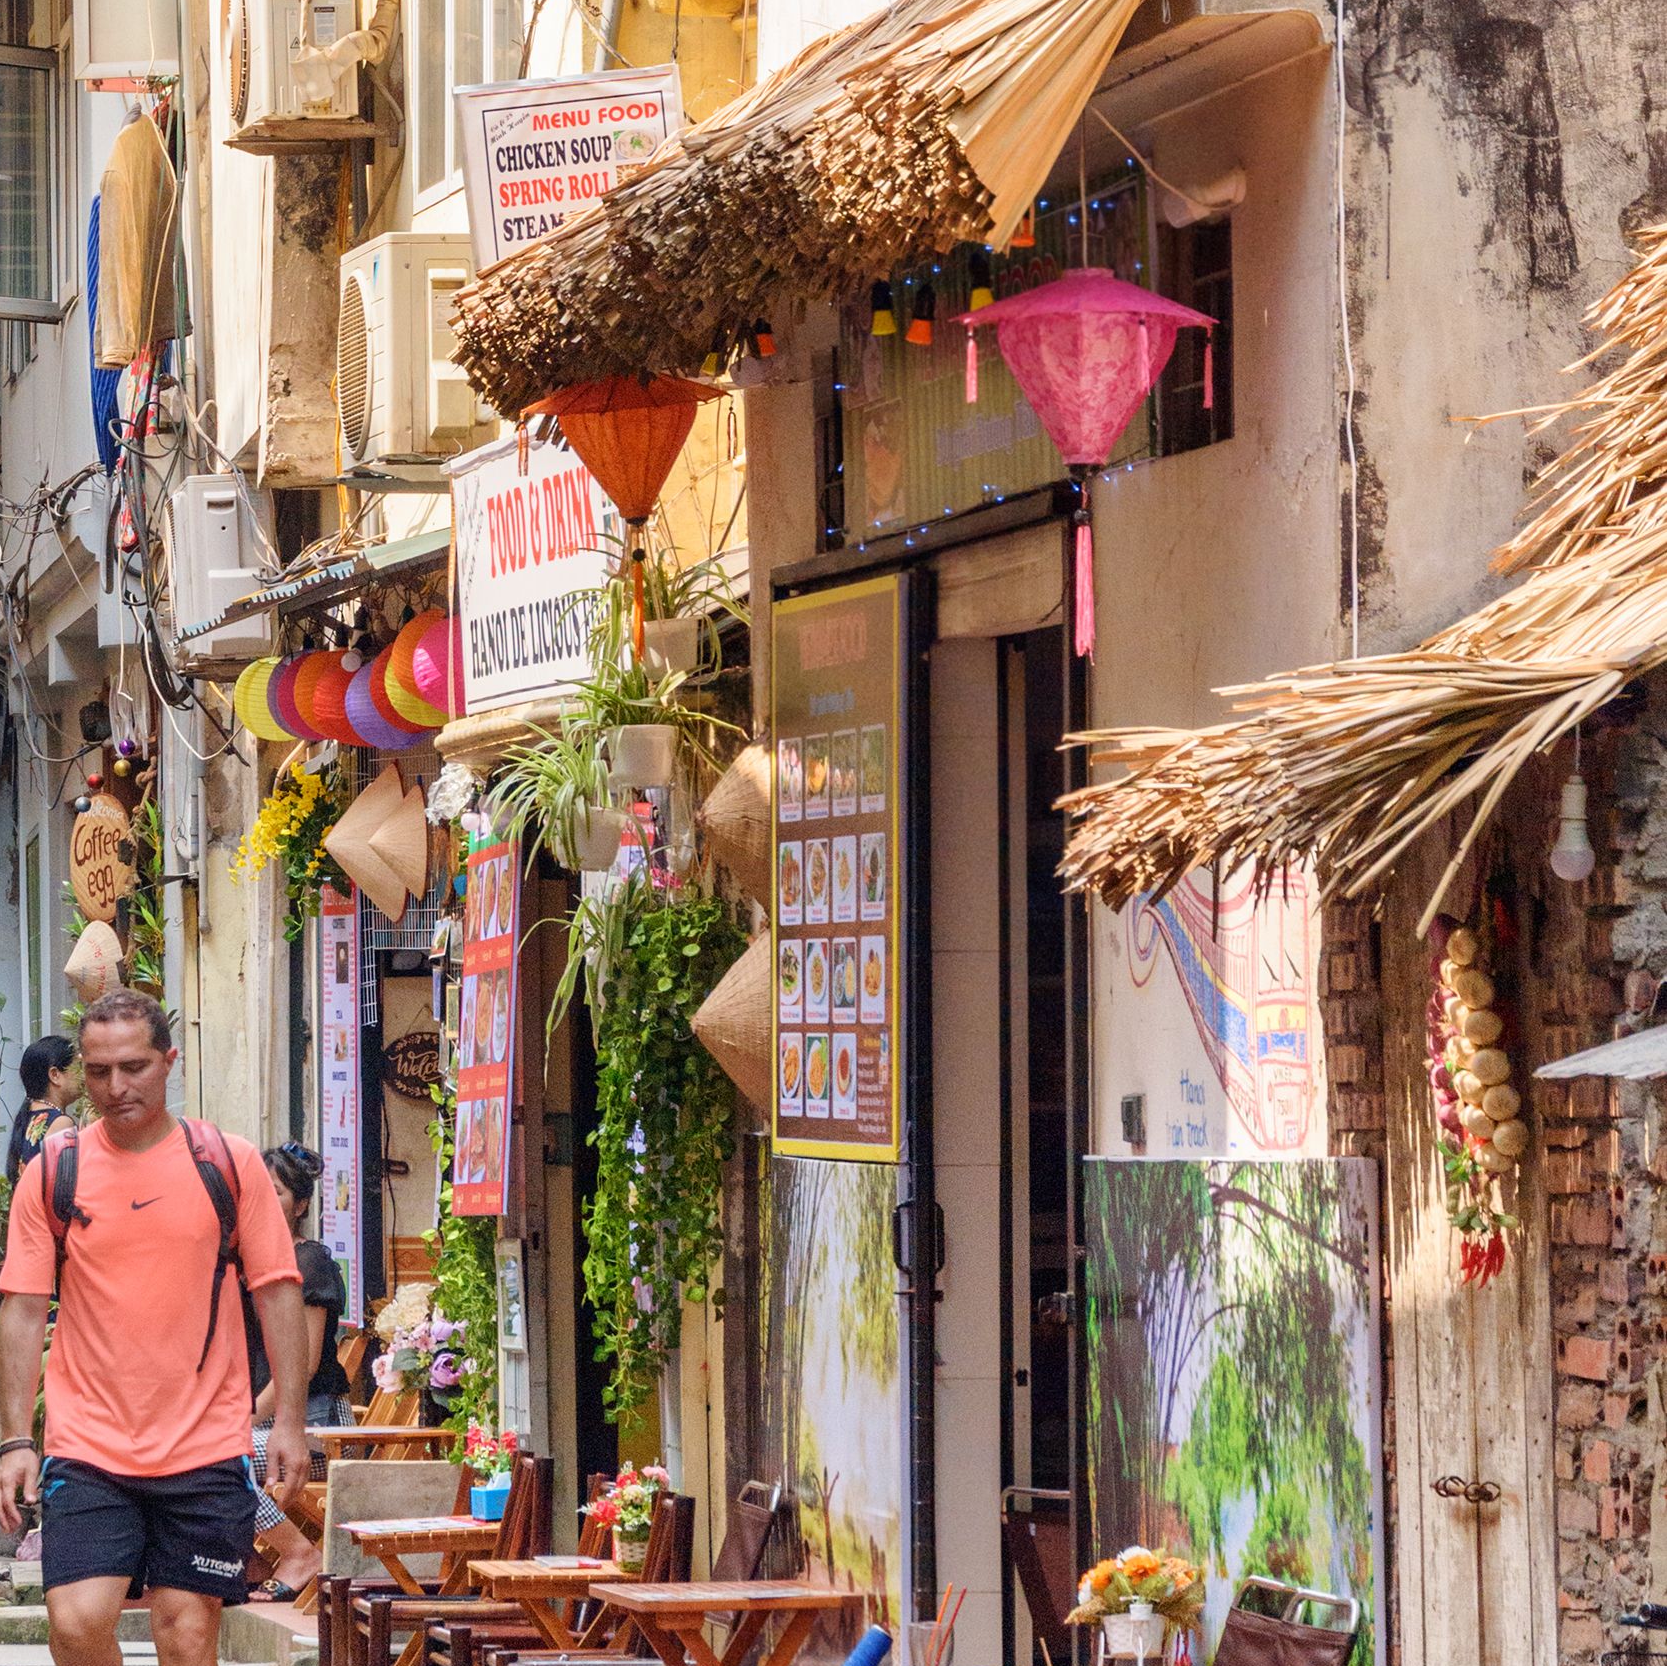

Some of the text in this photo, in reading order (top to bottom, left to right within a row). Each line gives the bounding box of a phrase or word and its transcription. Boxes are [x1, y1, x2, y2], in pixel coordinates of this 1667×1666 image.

[533, 102, 658, 131] MENU FOOD
[496, 135, 612, 173] CHICKEN SOUP
[499, 176, 565, 208] SPRING
[487, 486, 527, 579] FOOD
[529, 480, 542, 566] &
[542, 464, 598, 562] DRINK
[470, 609, 510, 679] HANOI
[510, 605, 530, 669] DE
[529, 591, 581, 664] LICIOUS
[74, 823, 121, 867] Coffee
[87, 864, 115, 909] egg
